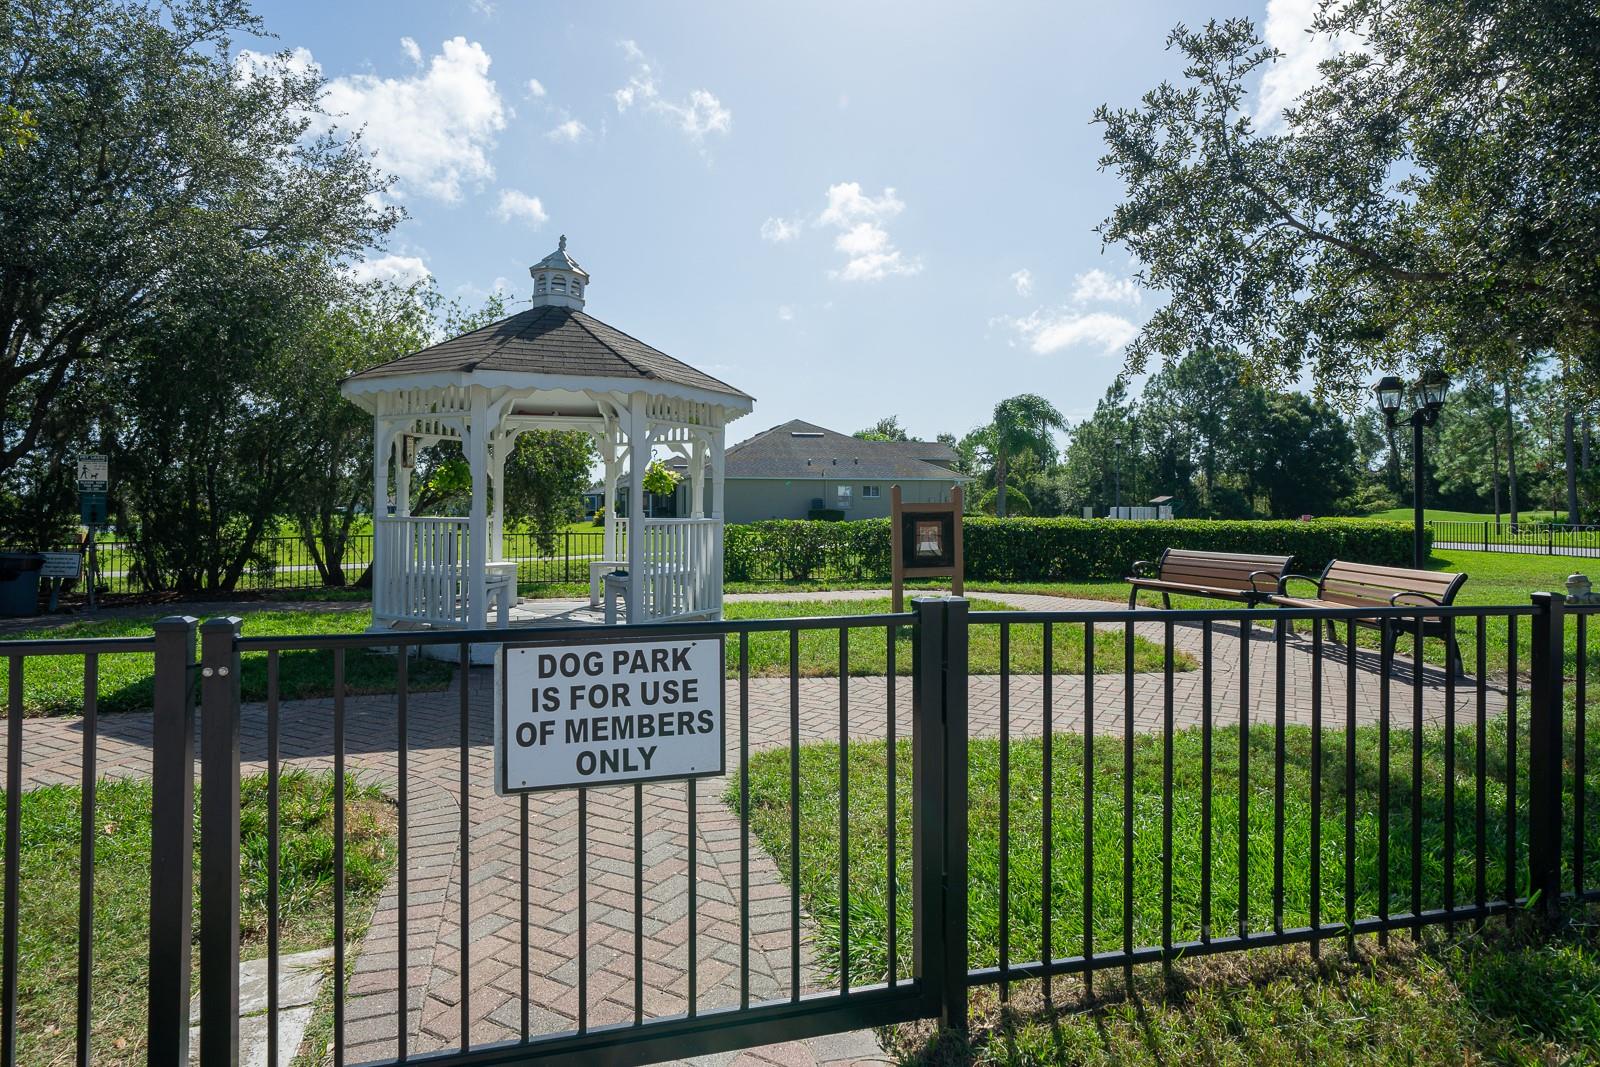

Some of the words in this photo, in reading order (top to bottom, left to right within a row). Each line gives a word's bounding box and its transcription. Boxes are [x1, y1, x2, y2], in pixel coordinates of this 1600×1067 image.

[538, 651, 604, 679] DOG
[612, 647, 692, 675] PARK
[531, 687, 561, 712] IS
[570, 683, 631, 710] FOR
[640, 678, 699, 706] USE
[515, 720, 556, 747] OF
[565, 709, 714, 744] MEMBERS
[576, 745, 658, 776] ONLY
